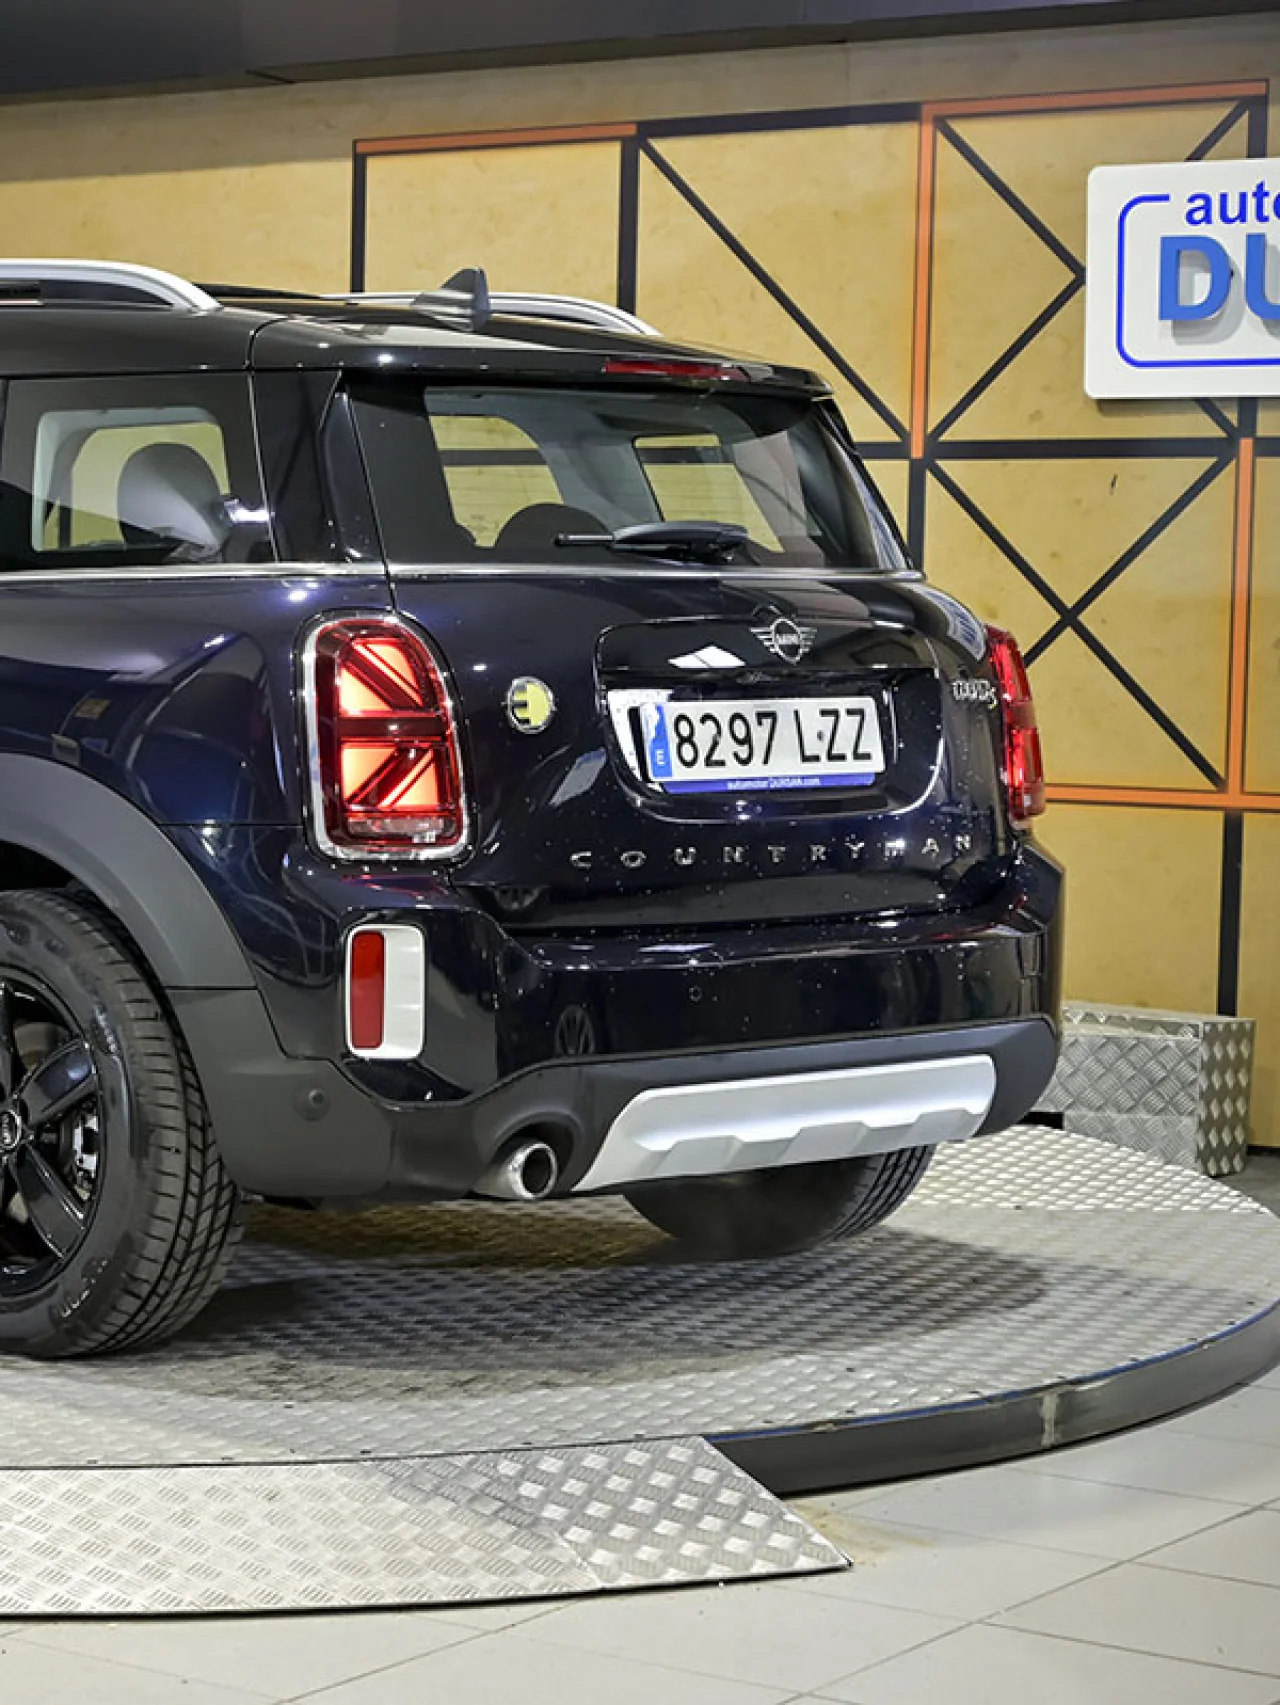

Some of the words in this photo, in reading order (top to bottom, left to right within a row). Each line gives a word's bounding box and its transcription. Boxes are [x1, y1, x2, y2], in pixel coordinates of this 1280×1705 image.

[1185, 180, 1280, 225] aut
[672, 708, 779, 769] 8297
[793, 707, 873, 765] LZZ
[655, 749, 667, 767] E
[570, 834, 971, 868] COUNTRYMAN
